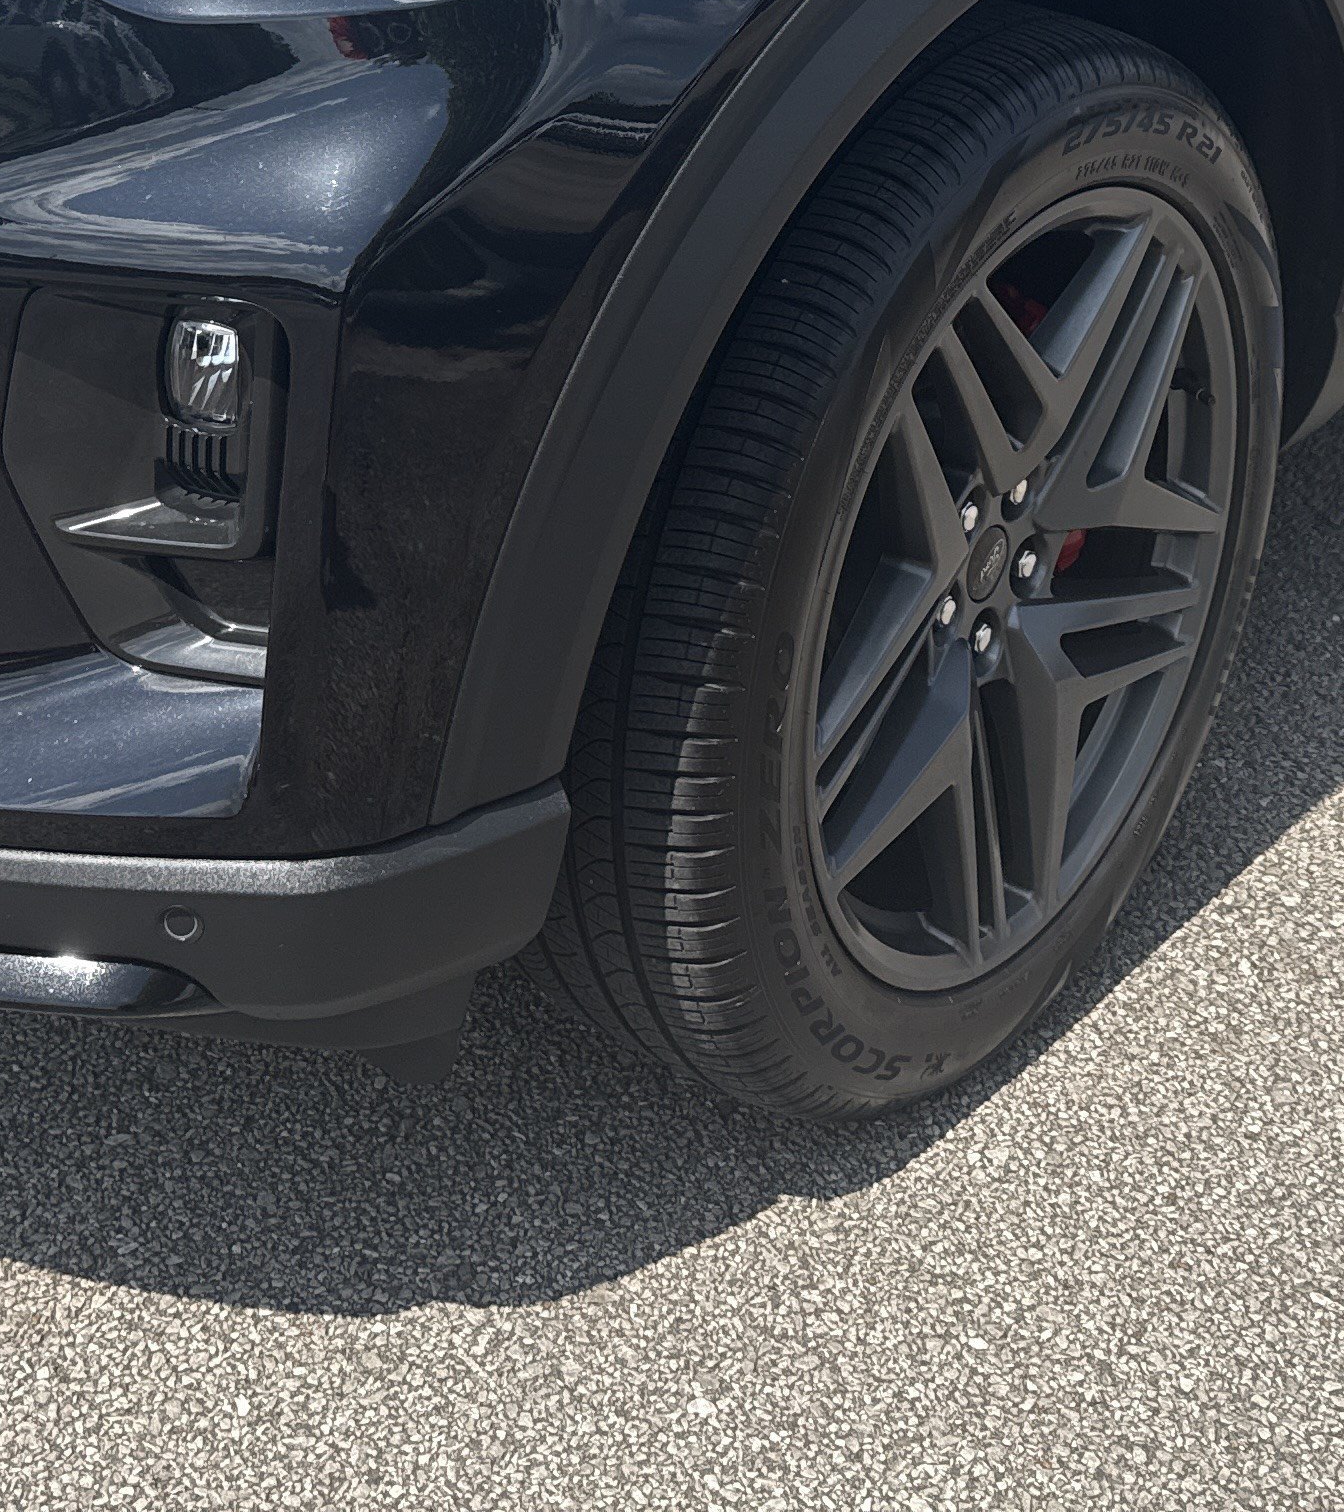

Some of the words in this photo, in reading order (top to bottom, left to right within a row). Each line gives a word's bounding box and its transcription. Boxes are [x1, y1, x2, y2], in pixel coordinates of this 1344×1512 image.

[1062, 106, 1175, 156] 275/45
[1176, 120, 1223, 165] R21
[758, 630, 795, 854] ZERO
[764, 885, 913, 1081] SCORPION
